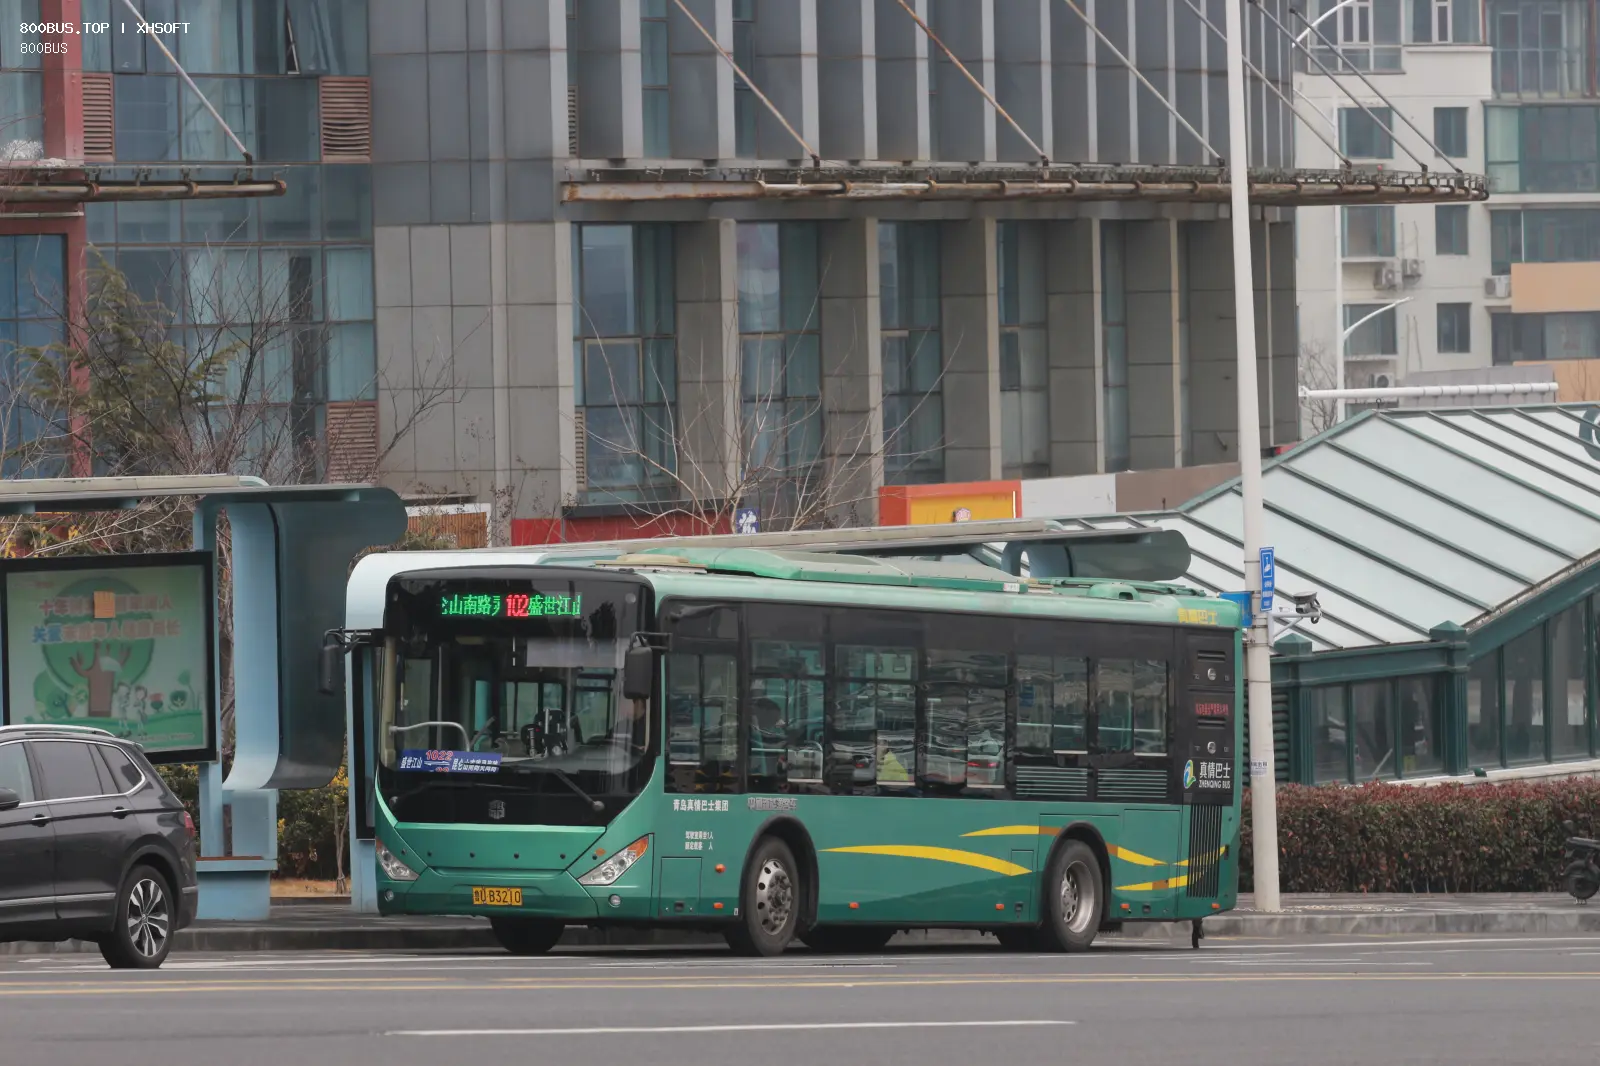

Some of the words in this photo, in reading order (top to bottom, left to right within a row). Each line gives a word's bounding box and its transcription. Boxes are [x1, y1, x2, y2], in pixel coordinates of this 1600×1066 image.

[426, 749, 453, 761] 1022
[1200, 761, 1231, 779] 真情巴士
[1199, 780, 1221, 788] ZHENQING
[1222, 780, 1231, 789] BUS
[673, 799, 729, 812] 青岛真情巴士集团
